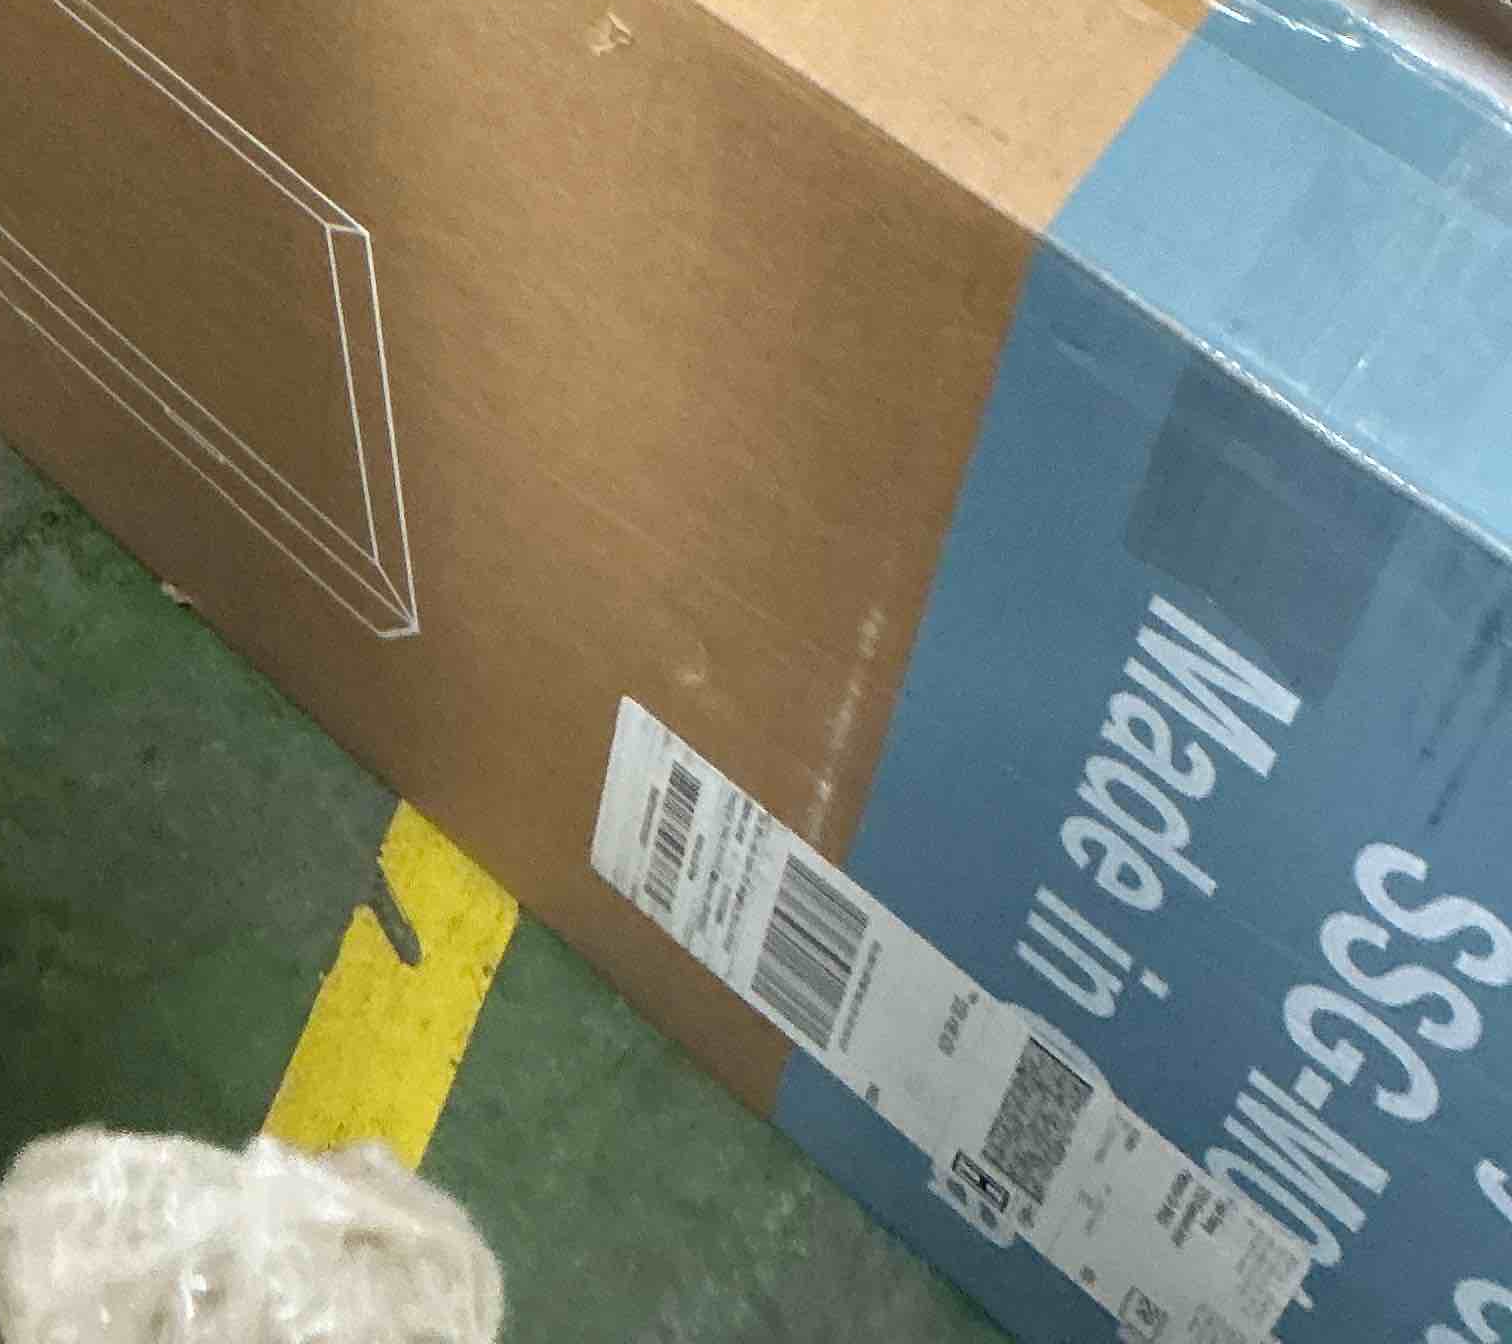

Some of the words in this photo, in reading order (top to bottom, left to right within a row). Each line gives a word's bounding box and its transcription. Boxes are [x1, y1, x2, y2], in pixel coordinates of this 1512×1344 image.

[1060, 593, 1303, 913] Made
[1014, 884, 1170, 1019] in
[1202, 840, 1512, 1310] SSG-M0
